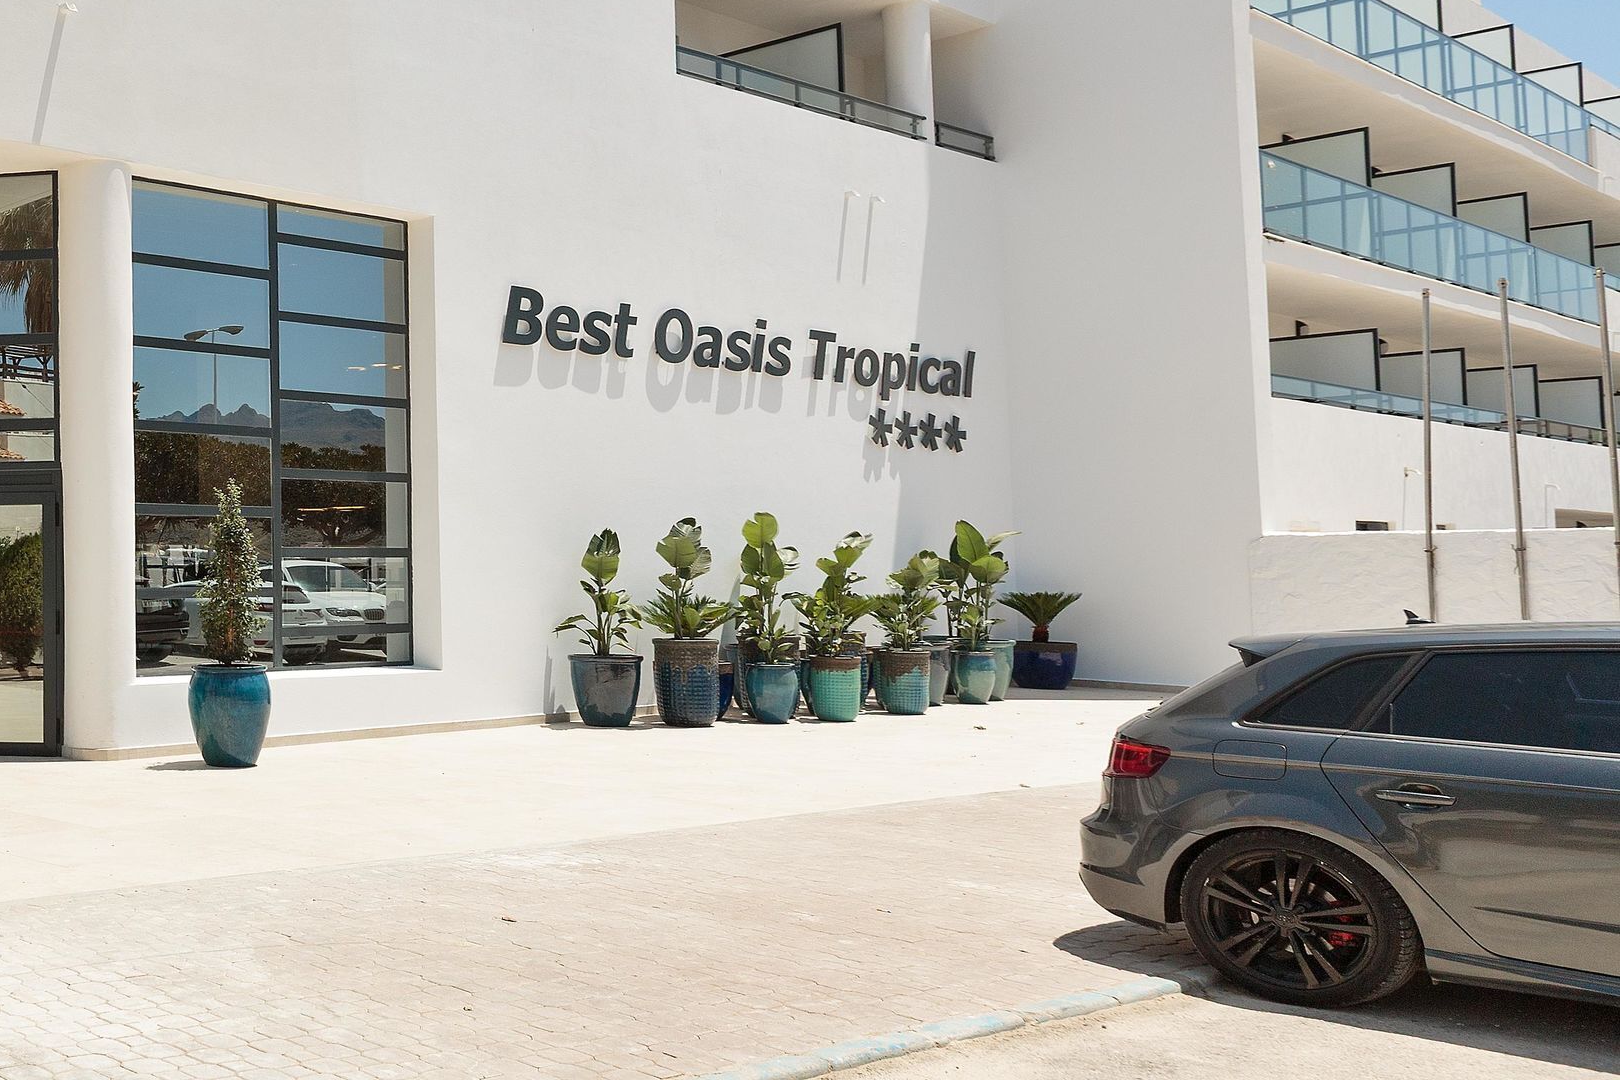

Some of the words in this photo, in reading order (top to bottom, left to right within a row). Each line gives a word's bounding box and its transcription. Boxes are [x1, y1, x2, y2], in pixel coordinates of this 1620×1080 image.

[503, 286, 638, 359] Best
[654, 309, 792, 377] Oasis
[809, 330, 976, 402] Tropical
